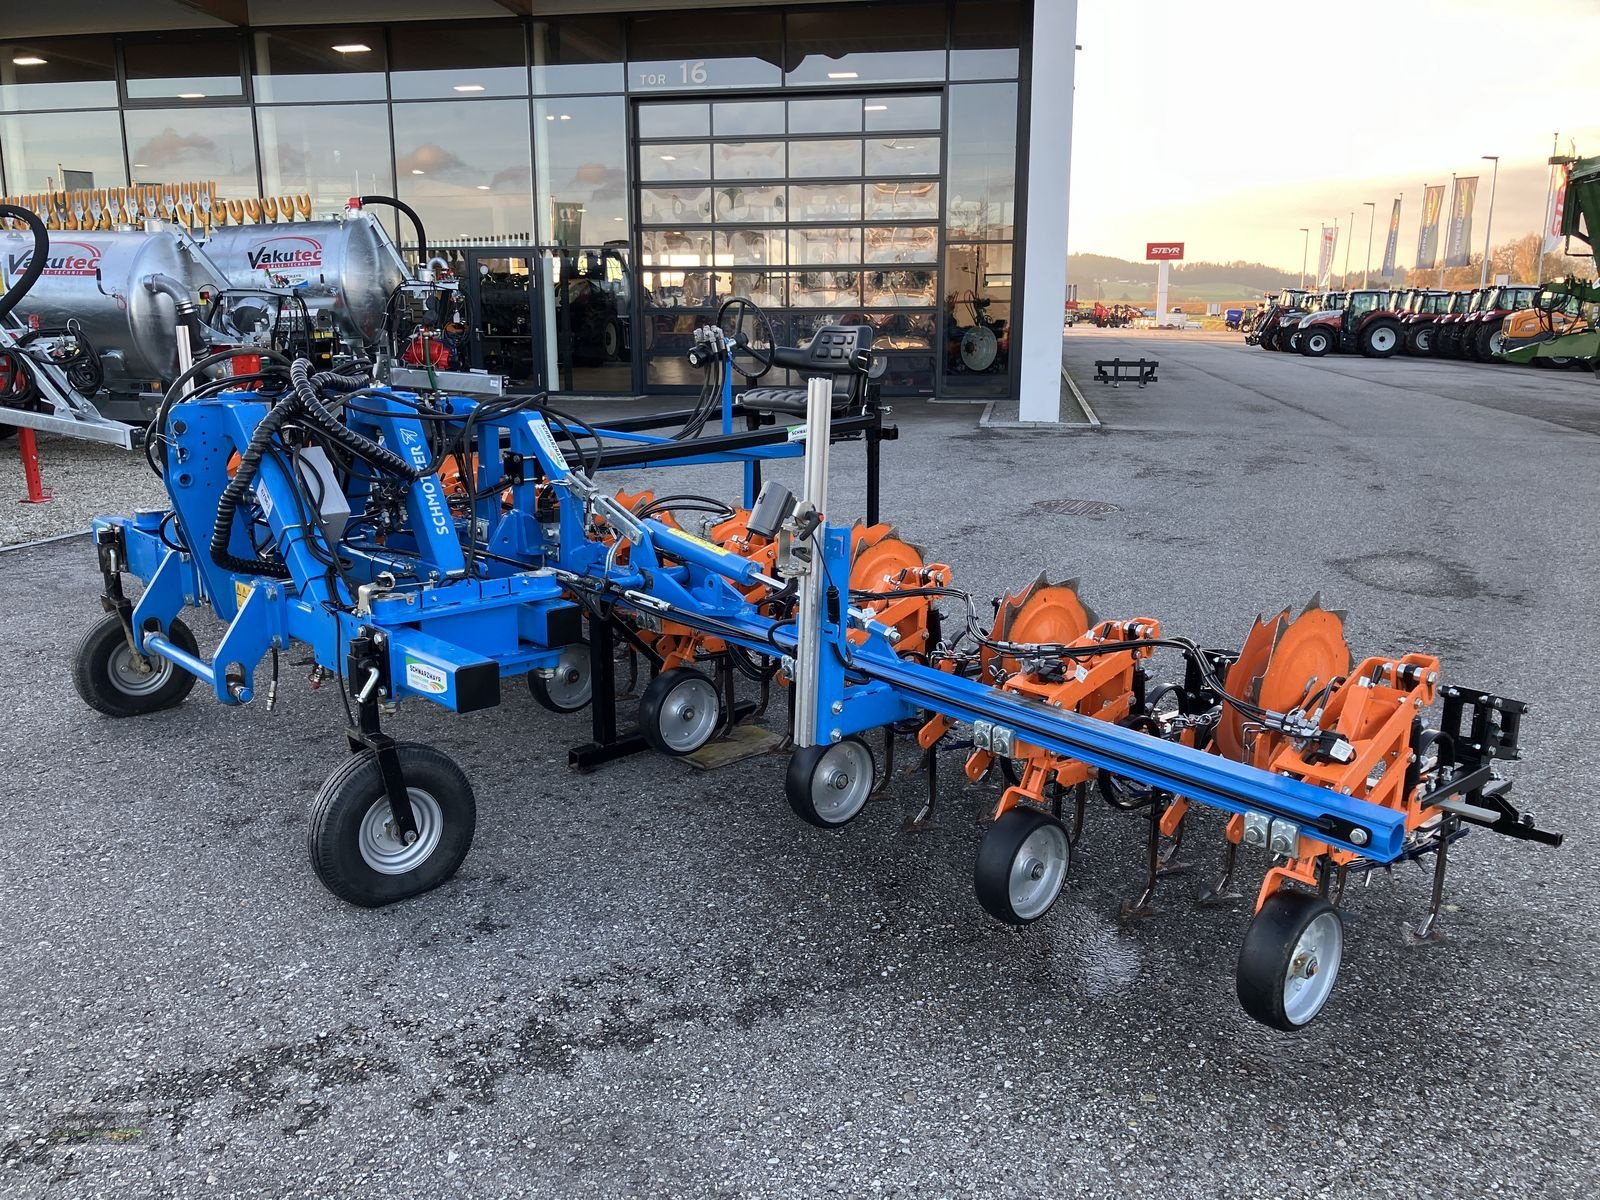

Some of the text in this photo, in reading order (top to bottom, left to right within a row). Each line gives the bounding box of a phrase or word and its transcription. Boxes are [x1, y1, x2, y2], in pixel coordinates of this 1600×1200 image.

[640, 61, 707, 85] TOR 16
[247, 246, 321, 269] Vakutec
[541, 423, 565, 463] SCHWARZMAYR
[409, 665, 441, 681] SCHWARZMAYR
